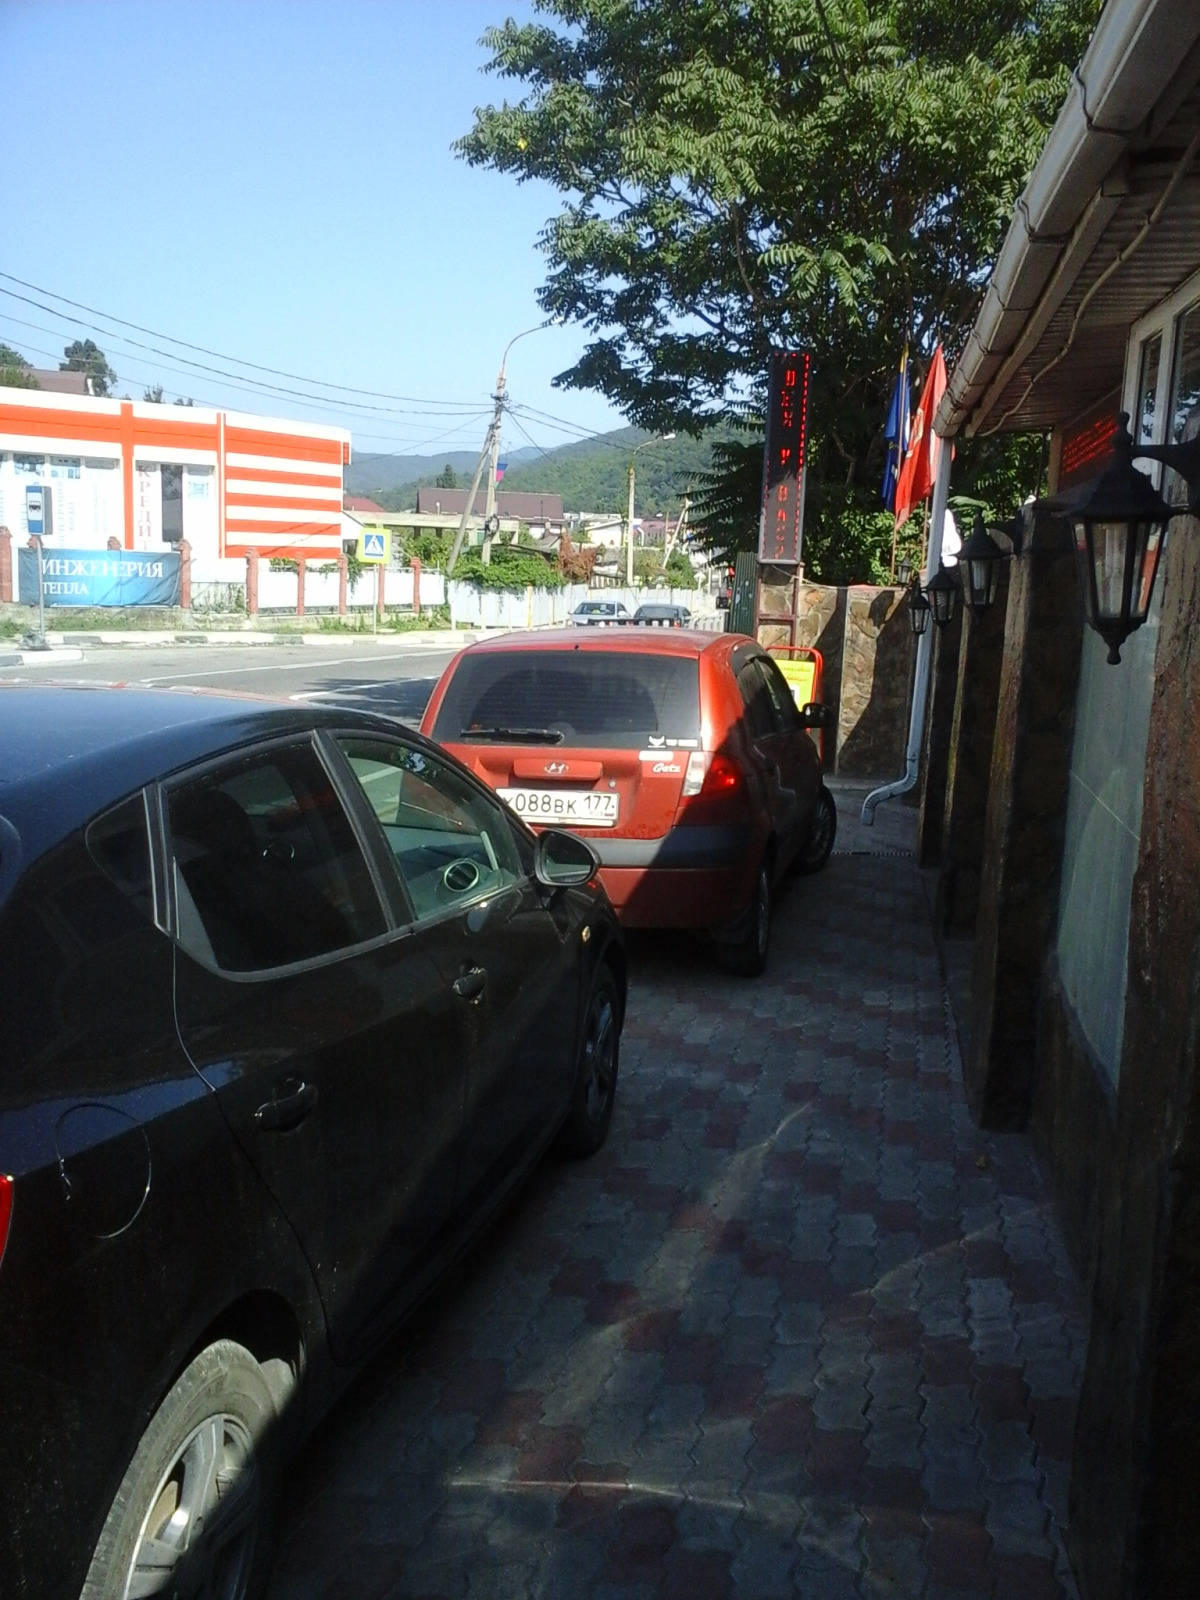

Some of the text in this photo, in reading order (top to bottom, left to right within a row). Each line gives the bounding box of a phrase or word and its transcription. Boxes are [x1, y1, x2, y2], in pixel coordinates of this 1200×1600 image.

[138, 464, 152, 550] КРЕДИТ
[42, 559, 163, 578] ИНЖЕНЕРИЯ
[42, 581, 89, 595] ТЕПЛА
[652, 762, 681, 773] Getz
[584, 795, 612, 810] 177
